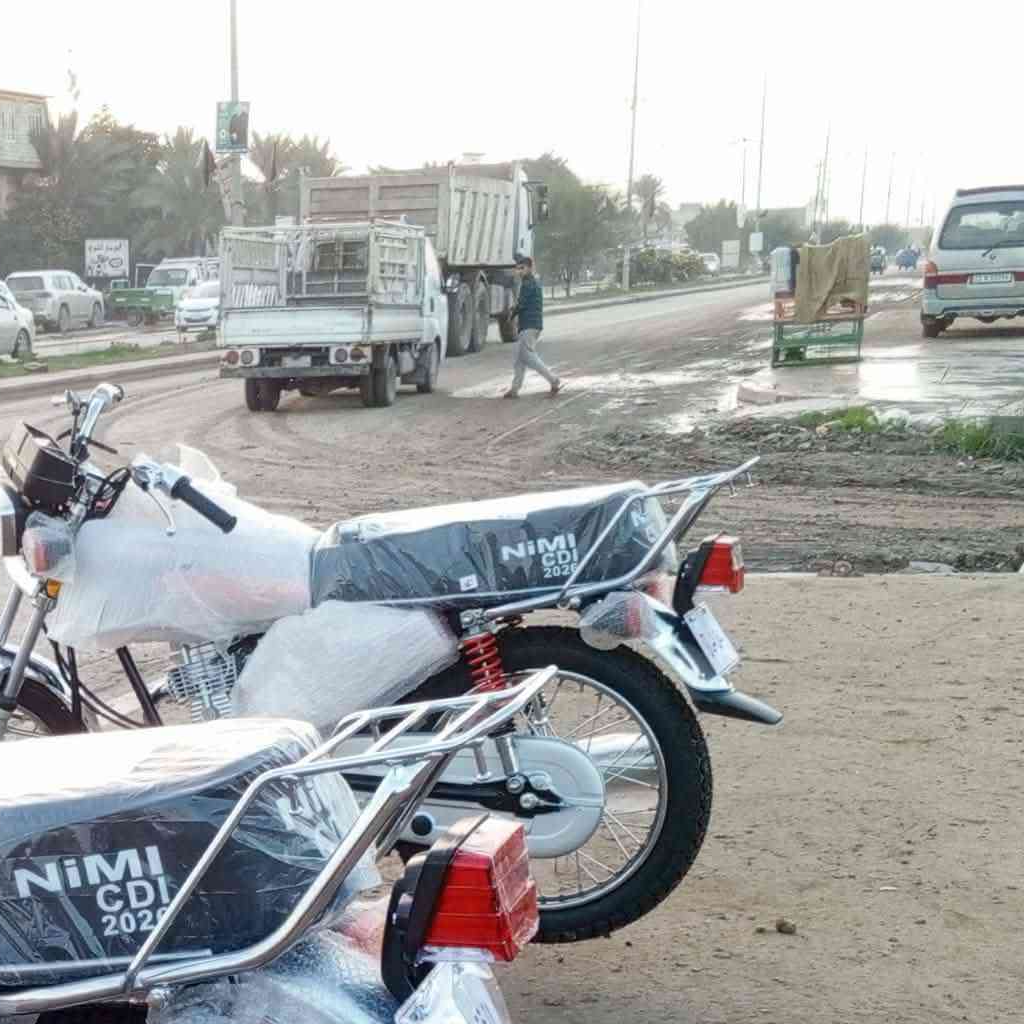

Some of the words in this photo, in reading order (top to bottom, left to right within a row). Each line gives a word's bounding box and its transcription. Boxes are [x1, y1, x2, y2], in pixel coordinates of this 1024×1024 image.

[542, 548, 578, 567] CDI
[14, 845, 164, 898] NiMI
[96, 875, 171, 912] CDI
